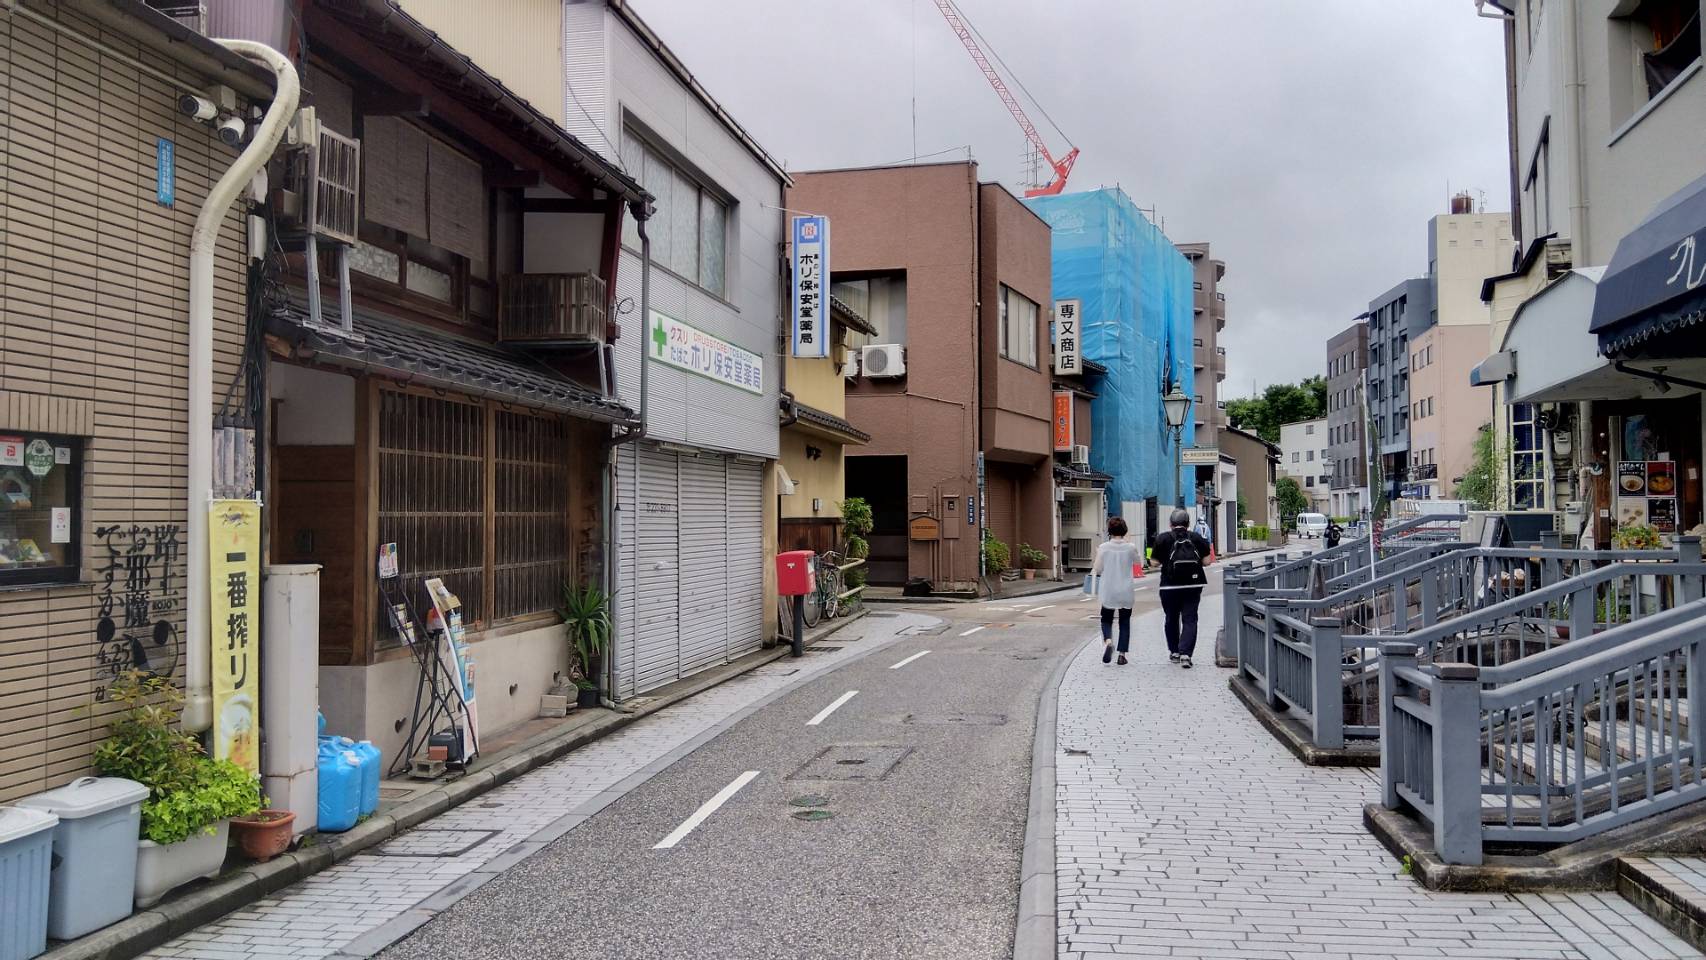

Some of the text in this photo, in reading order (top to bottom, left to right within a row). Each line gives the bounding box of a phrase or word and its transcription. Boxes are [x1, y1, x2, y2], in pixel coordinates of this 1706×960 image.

[670, 326, 688, 345] クスリ
[799, 253, 814, 344] ホリ保安堂薬局
[1060, 304, 1075, 370] 専又商店
[670, 344, 761, 390] たばこ ホリ保安堂薬局
[125, 525, 151, 627] お邪魔
[226, 552, 249, 690] 一番搾り
